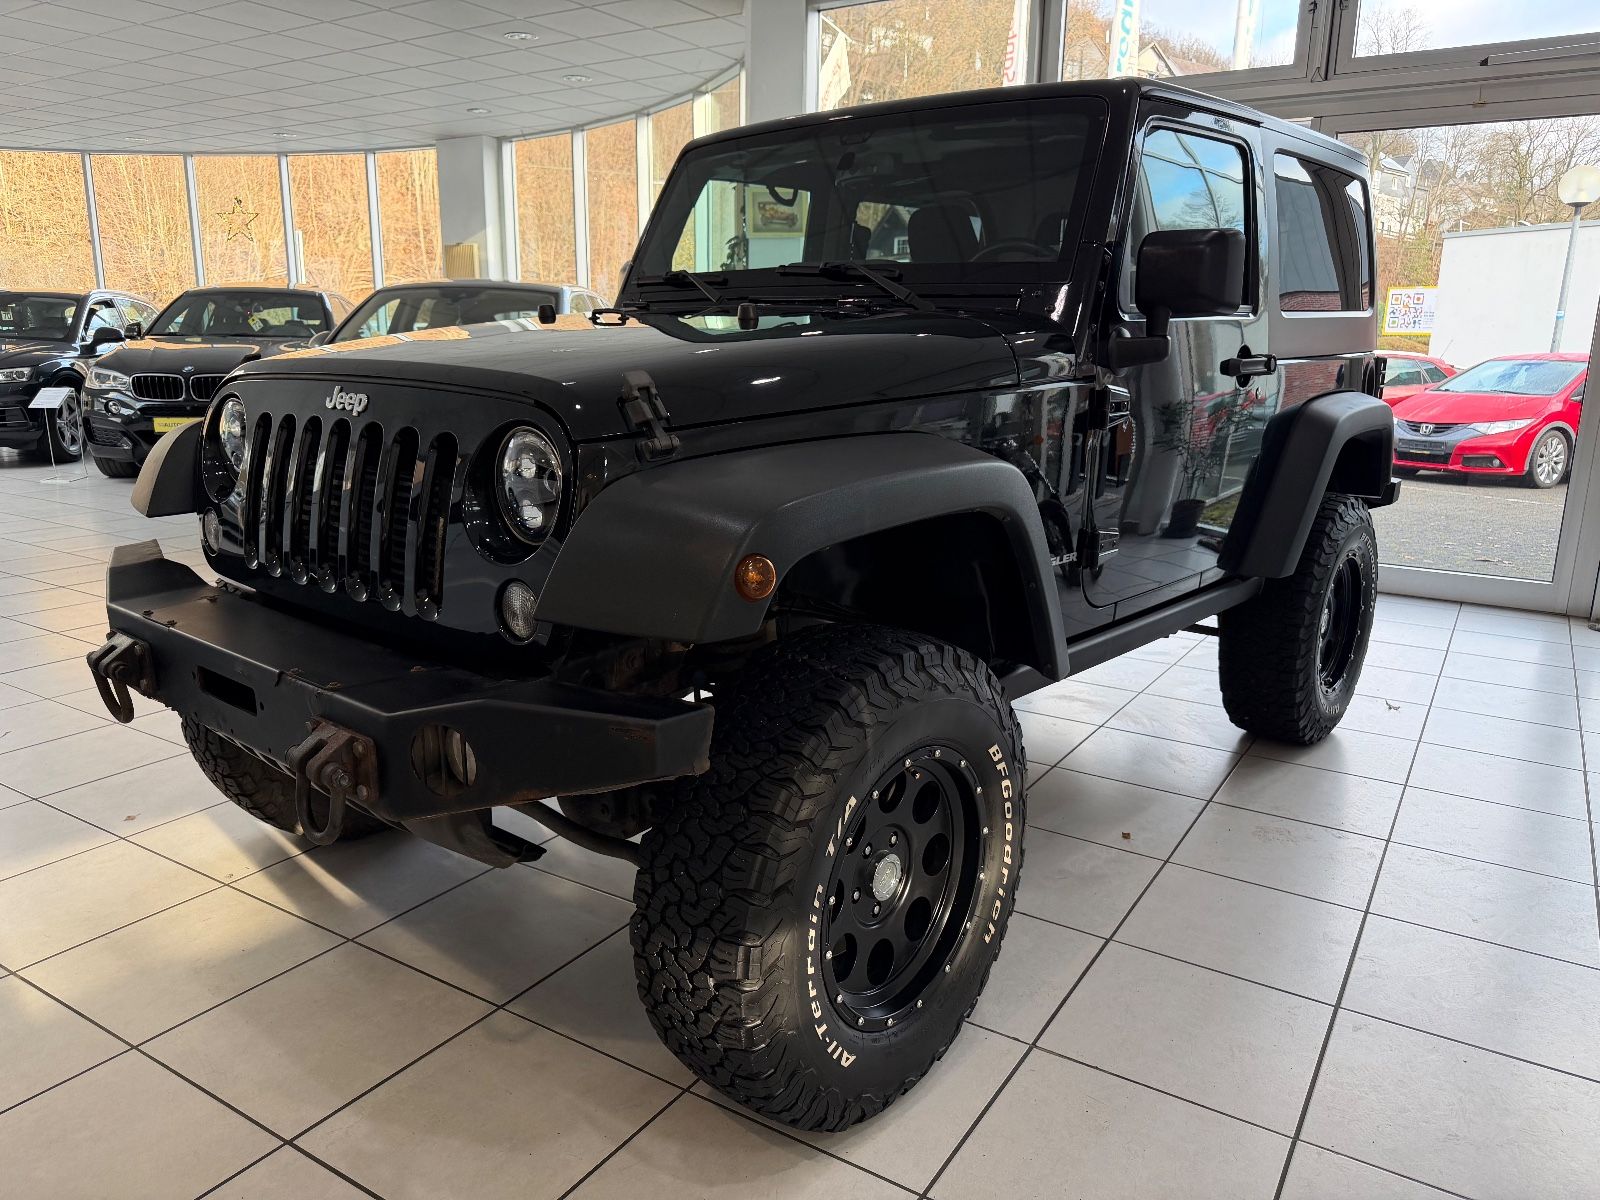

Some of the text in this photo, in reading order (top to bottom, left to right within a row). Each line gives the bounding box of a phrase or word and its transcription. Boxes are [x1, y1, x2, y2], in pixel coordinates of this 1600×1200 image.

[325, 385, 368, 417] Jeep
[807, 795, 857, 1068] All-Terrain T/A
[983, 743, 1013, 945] BFGoodrich
